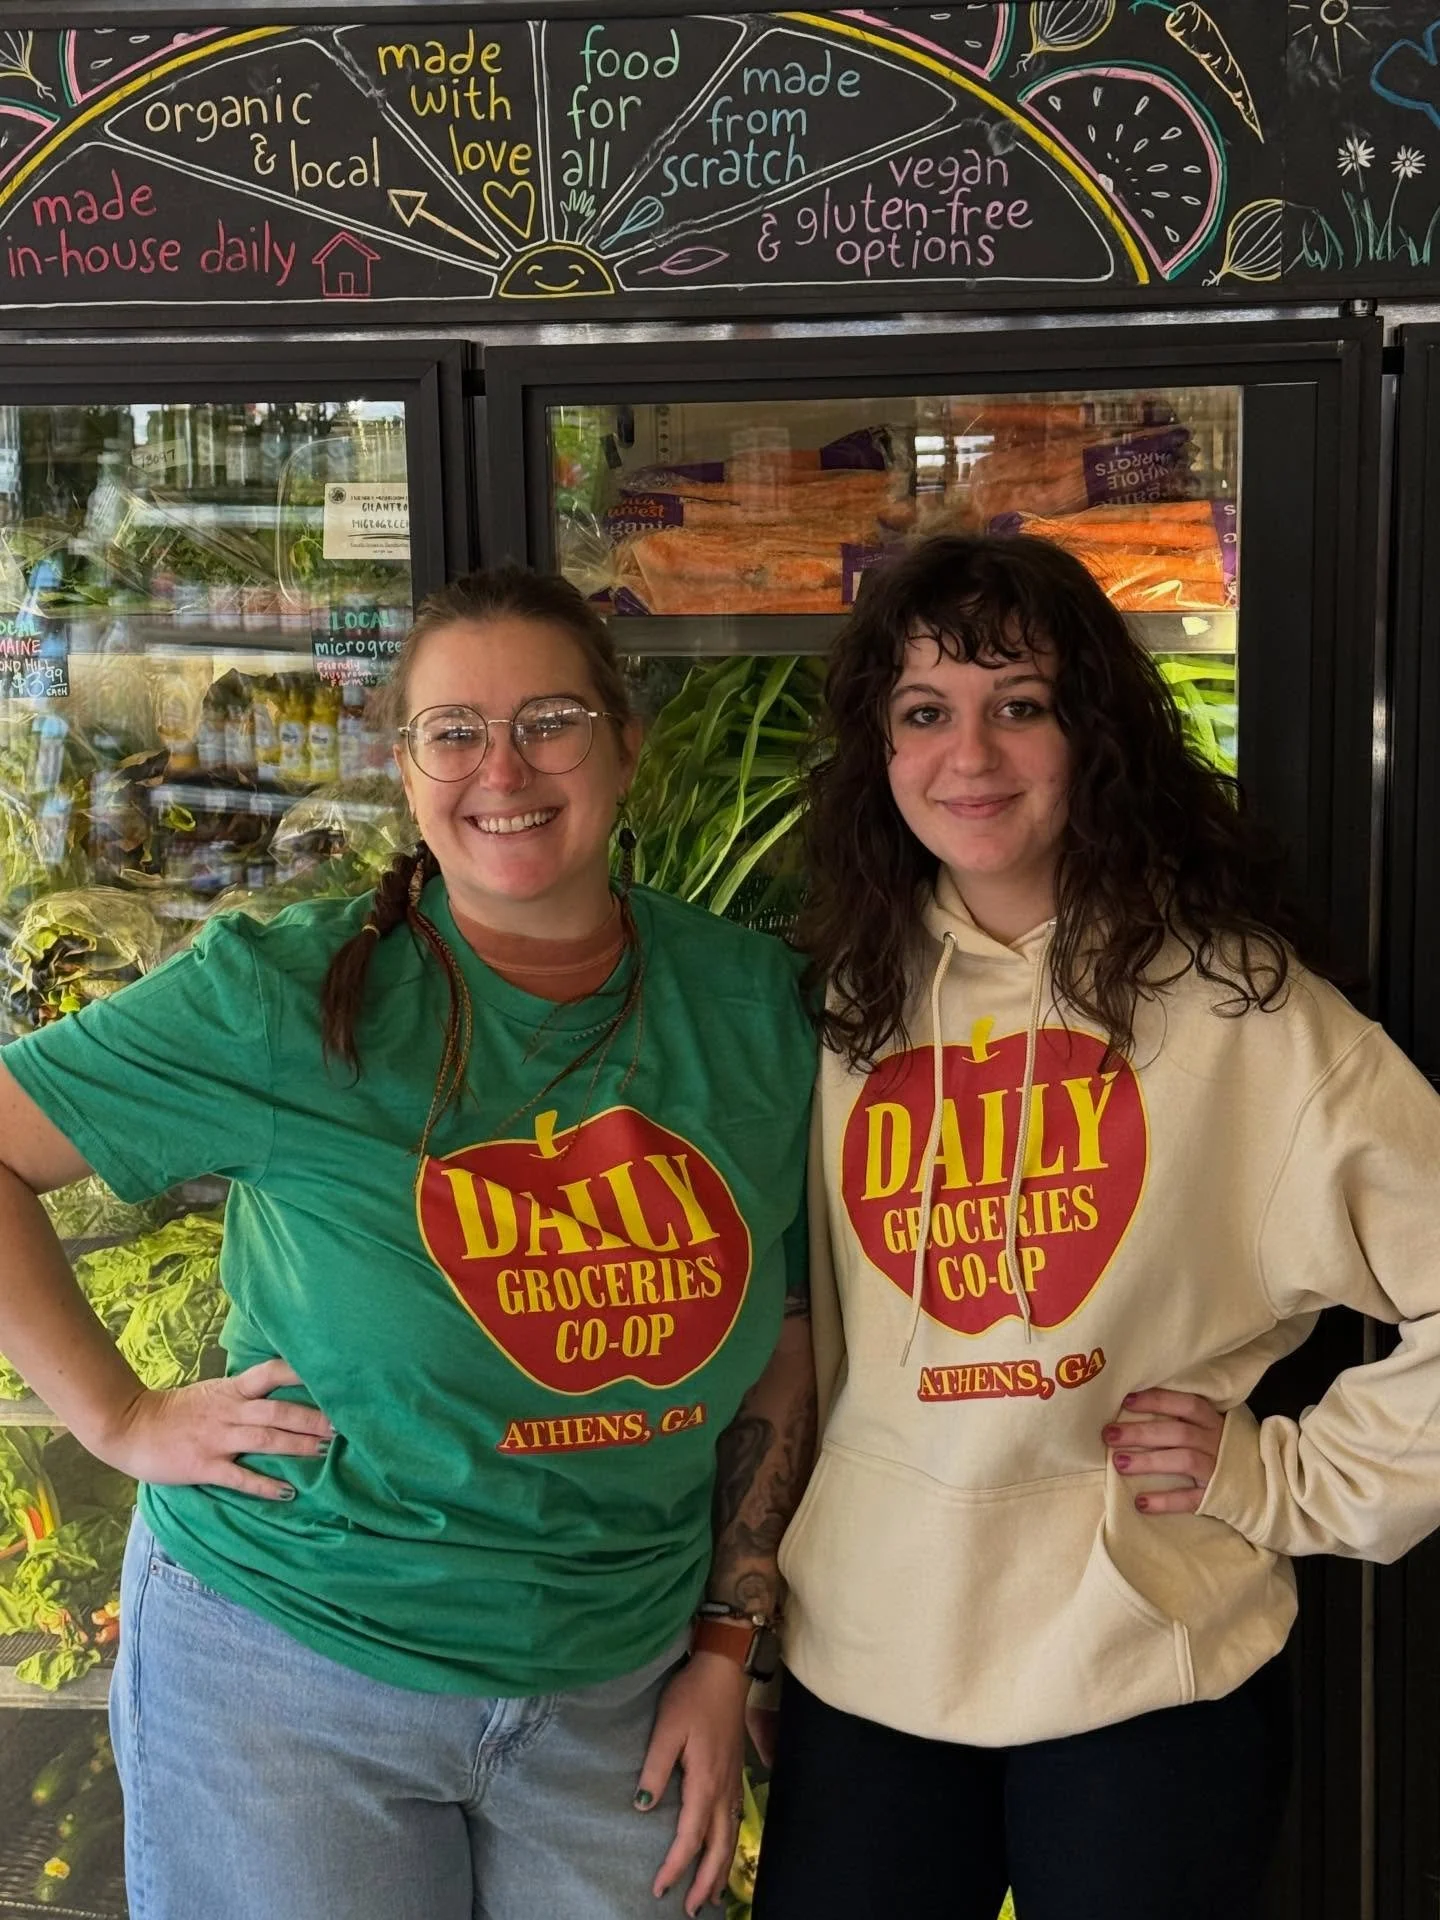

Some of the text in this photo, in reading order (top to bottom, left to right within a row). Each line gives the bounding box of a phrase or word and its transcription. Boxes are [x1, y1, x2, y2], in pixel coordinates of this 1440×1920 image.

[378, 30, 502, 78] made
[580, 25, 680, 79] food
[742, 50, 861, 99] made
[144, 79, 312, 142] organic
[410, 79, 512, 124] with
[567, 85, 642, 139] for
[706, 97, 806, 144] from
[251, 133, 381, 193] & local
[448, 124, 533, 176] love
[562, 141, 610, 190] all
[661, 138, 807, 197] scratch
[889, 148, 1009, 191] vegan
[33, 170, 156, 226] made
[756, 183, 1033, 263] & gluten-free
[7, 220, 297, 286] in-house daily
[835, 231, 996, 276] options
[331, 610, 394, 631] LOCAL
[25, 658, 55, 673] HILL
[861, 1071, 1118, 1200] DAILY
[441, 1154, 720, 1260] DAILY
[883, 1184, 1099, 1254] GROCERIES
[497, 1254, 723, 1315] GROCERIES
[937, 1246, 1046, 1301] CO-OP
[555, 1313, 674, 1364] CO-OP
[919, 1349, 1105, 1397] ATHENS, GA
[500, 1405, 705, 1449] ATHENS, GA
